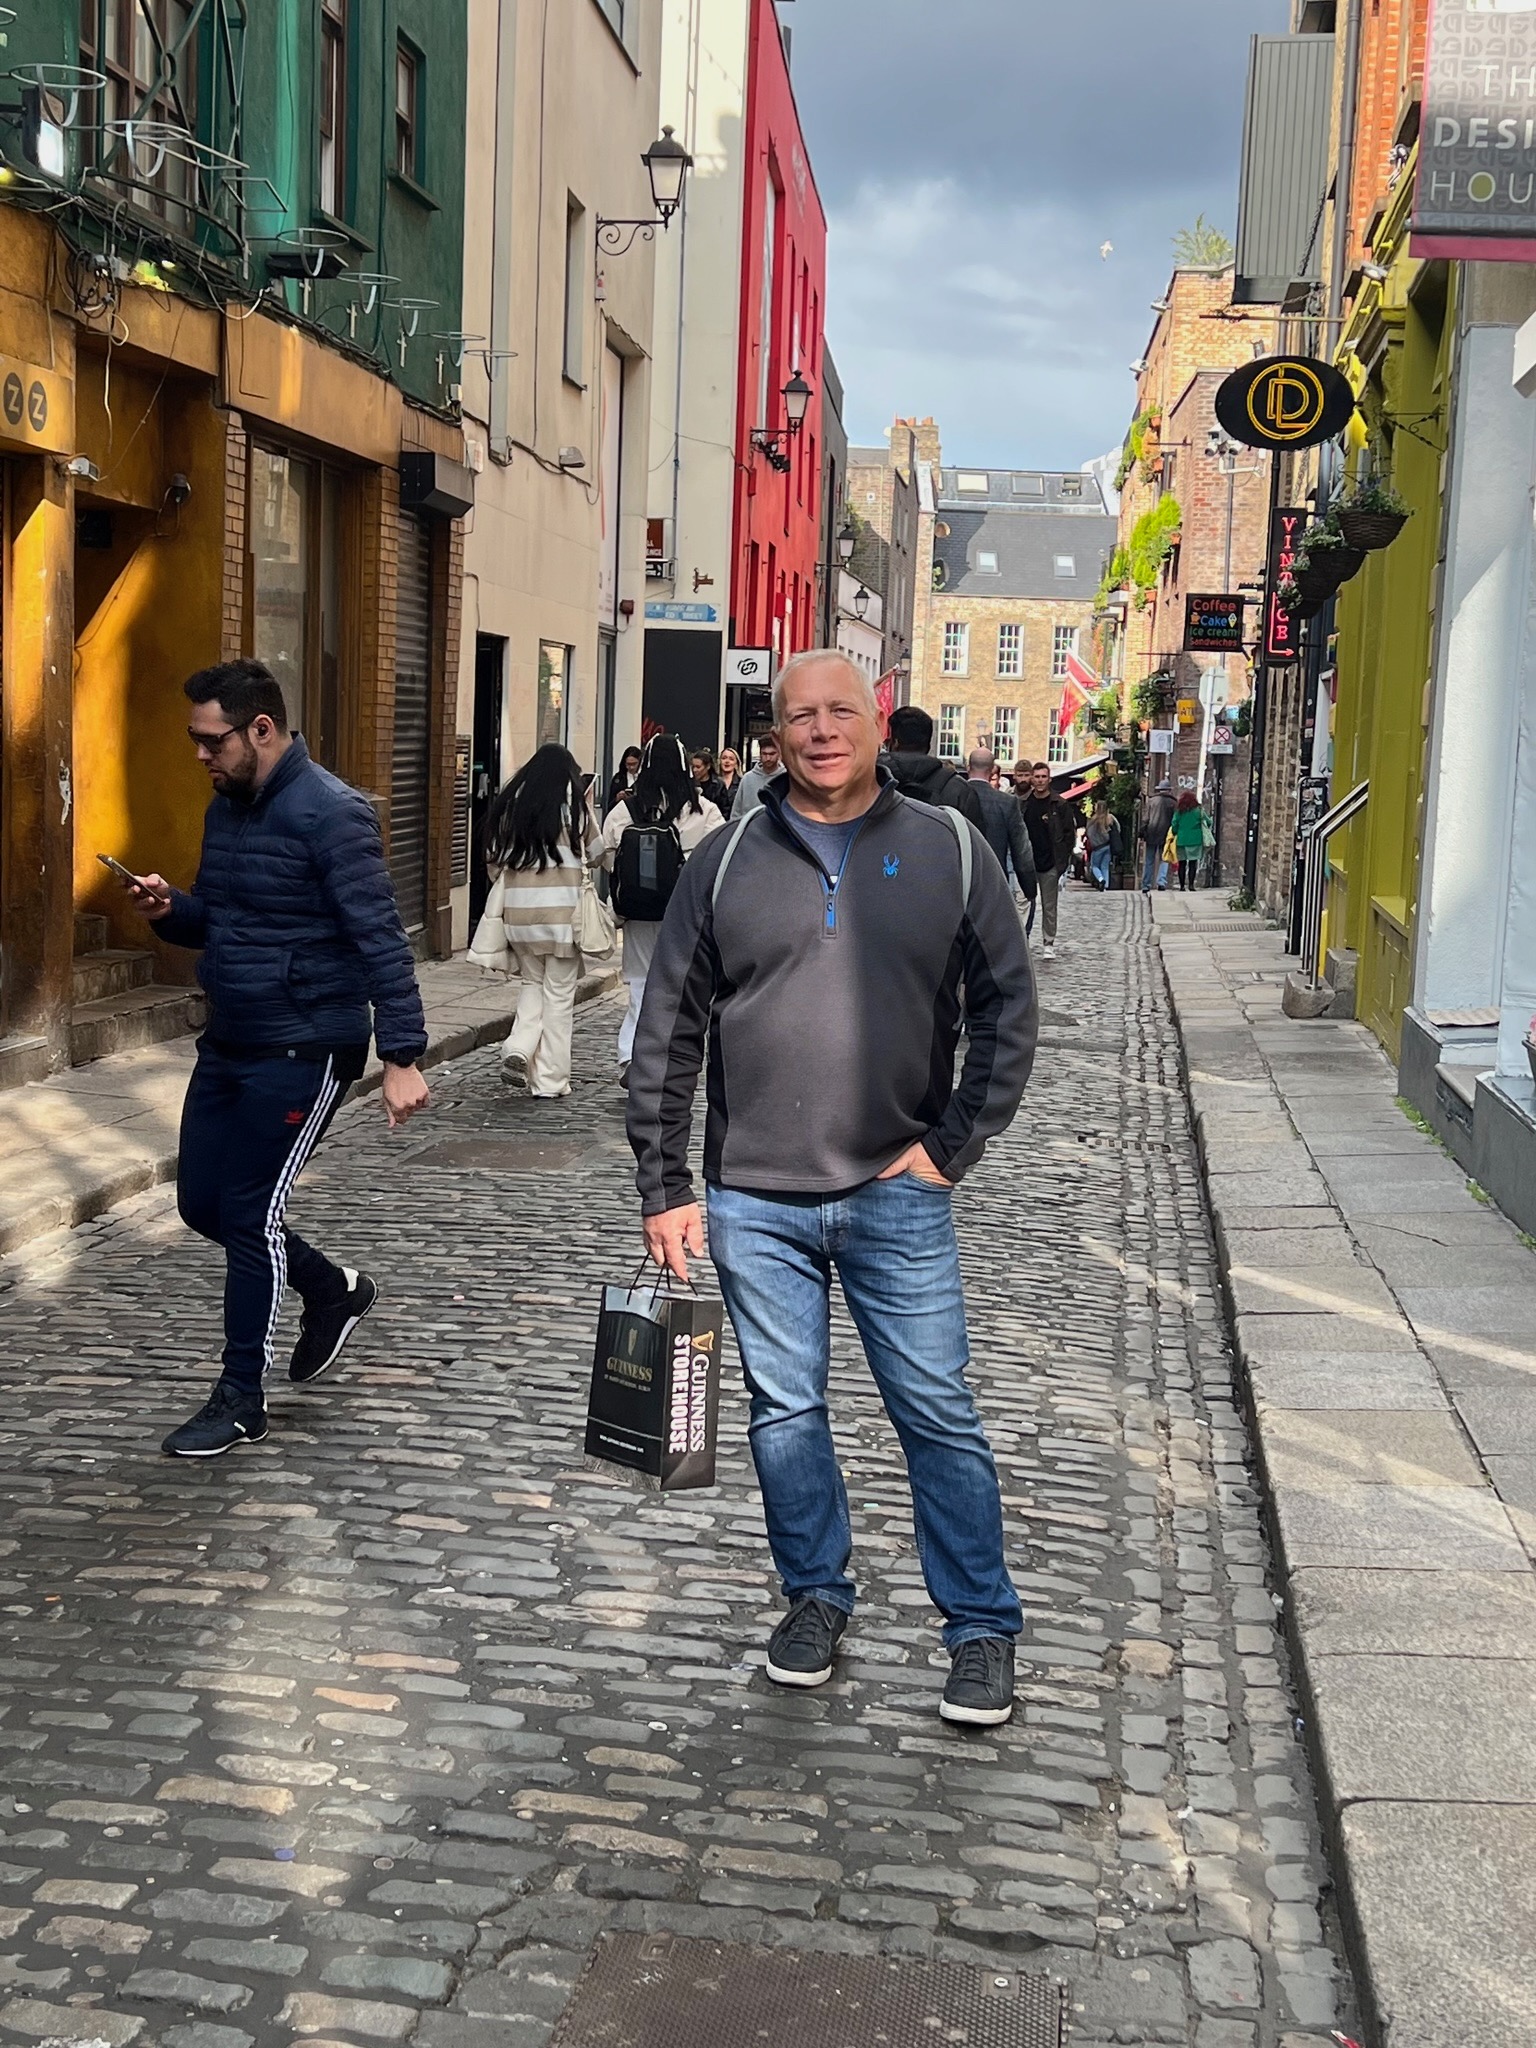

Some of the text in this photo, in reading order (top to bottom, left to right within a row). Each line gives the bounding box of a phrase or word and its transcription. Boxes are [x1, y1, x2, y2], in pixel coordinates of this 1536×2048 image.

[1276, 516, 1298, 640] VINTGE
[1192, 599, 1236, 612] Coffee
[1200, 614, 1228, 627] Cake
[1207, 627, 1238, 637] cream
[1189, 637, 1238, 647] Sandwiches
[607, 1357, 652, 1382] GUINNESS
[668, 1334, 691, 1454] STOREHOUSE
[690, 1354, 709, 1452] GUINNESS
